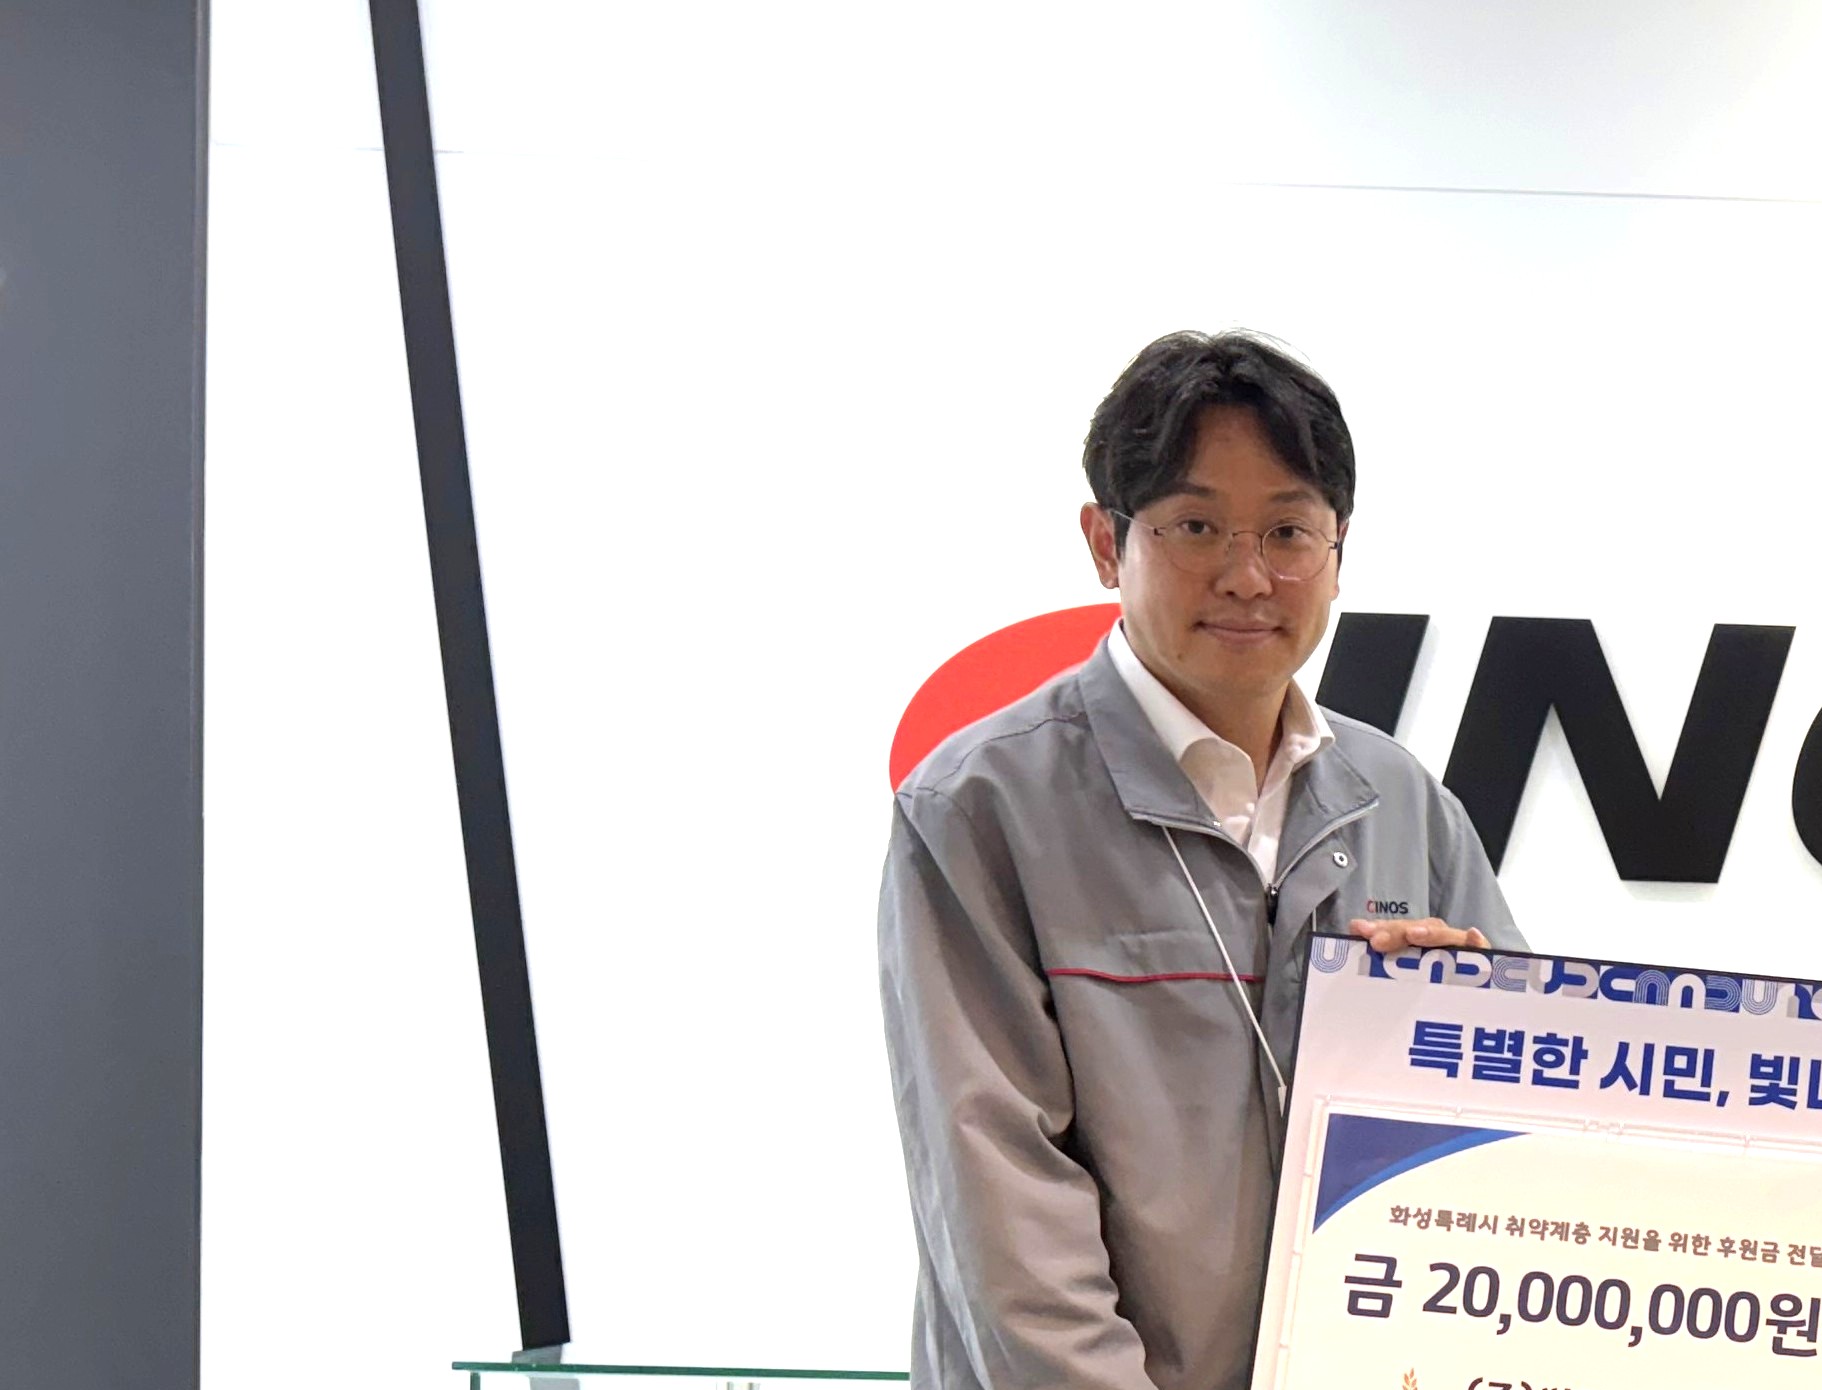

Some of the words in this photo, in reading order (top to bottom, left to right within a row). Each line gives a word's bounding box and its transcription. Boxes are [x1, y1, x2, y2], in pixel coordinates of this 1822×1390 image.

[1366, 899, 1409, 915] CINOS
[1408, 1020, 1589, 1089] 특별한
[1599, 1041, 1729, 1107] 시민,
[1389, 1205, 1499, 1235] 화성특례시
[1505, 1215, 1592, 1245] 취약계층
[1598, 1226, 1662, 1252] 지원을
[1668, 1232, 1712, 1258] 위한
[1717, 1236, 1780, 1264] 후원금
[1344, 1253, 1402, 1319] 금
[1422, 1262, 1821, 1357] 20,000,000원
